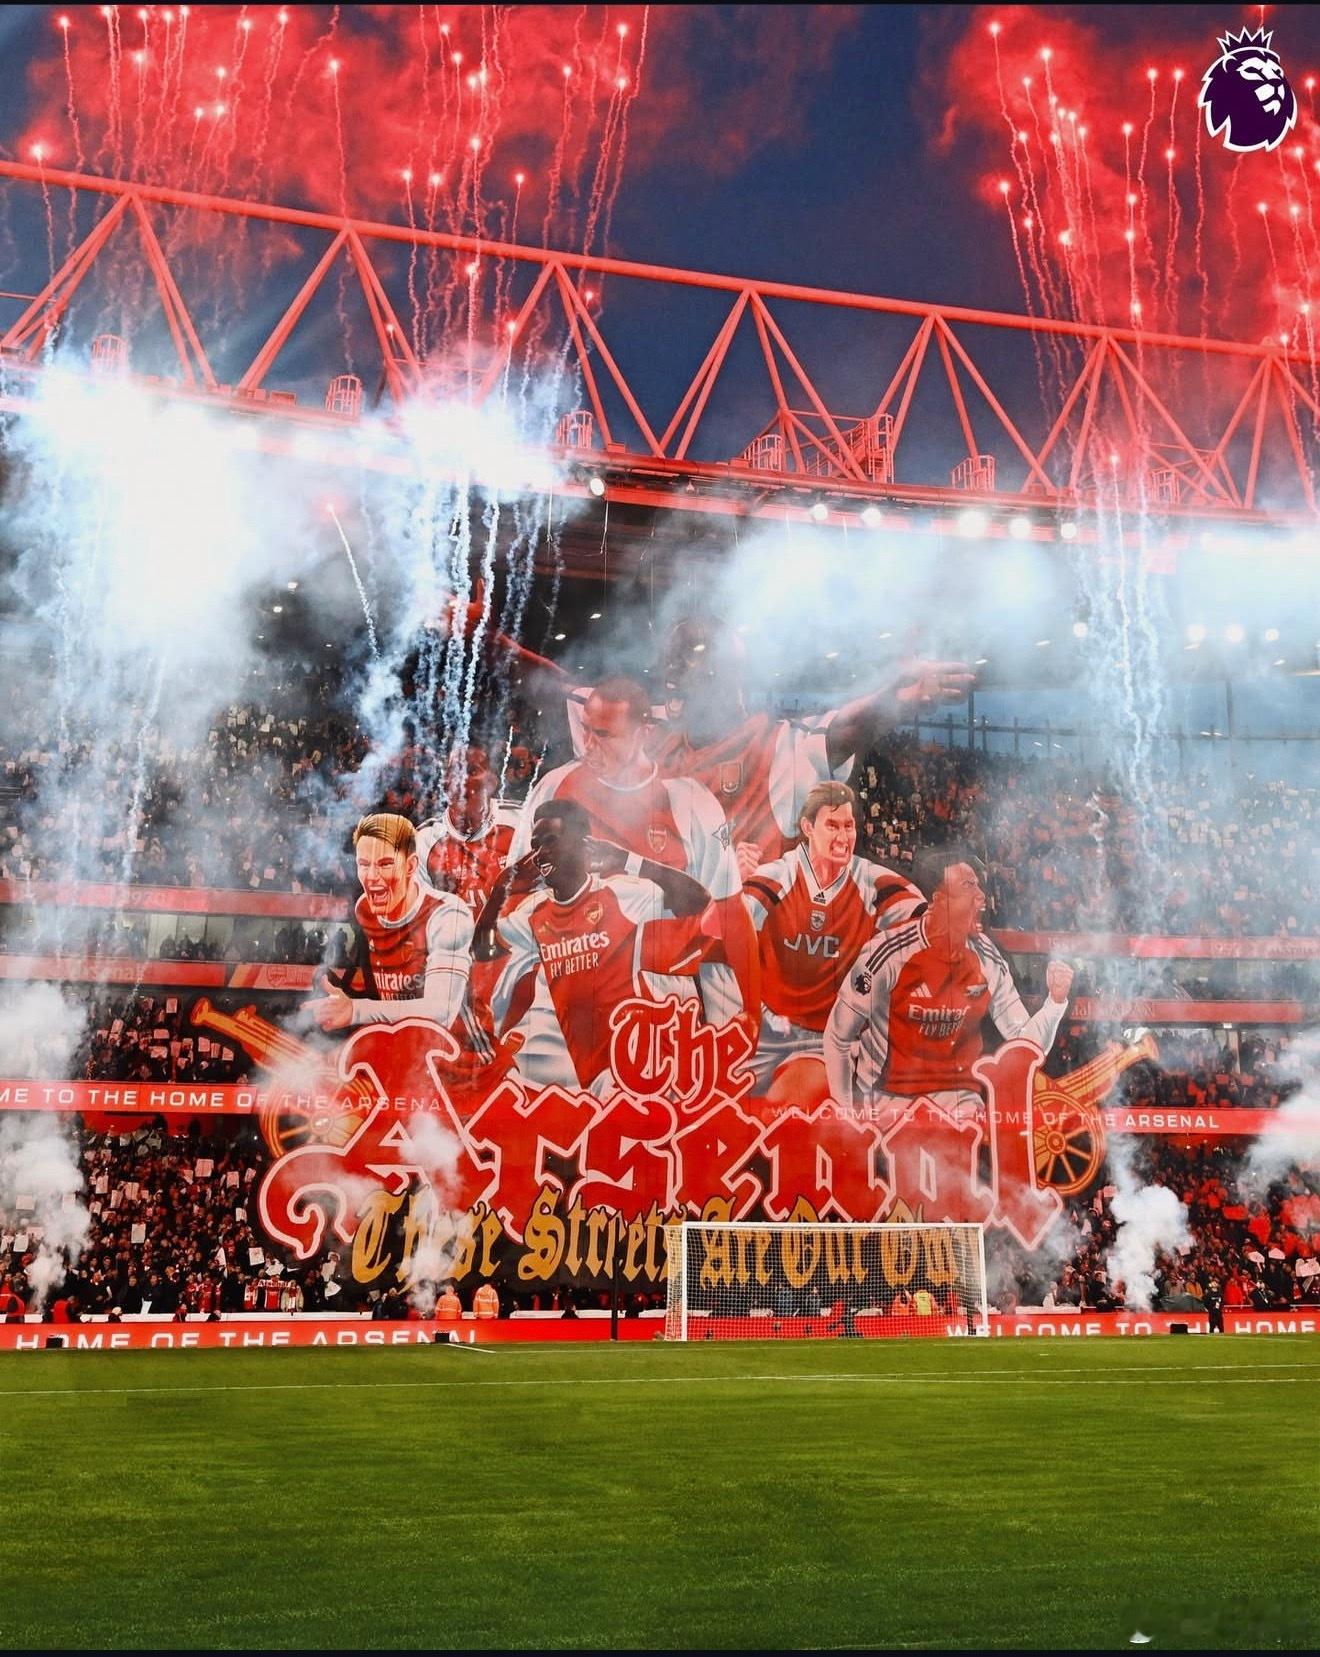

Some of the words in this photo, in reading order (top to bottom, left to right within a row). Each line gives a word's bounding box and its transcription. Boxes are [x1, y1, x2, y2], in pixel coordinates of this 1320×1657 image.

[540, 931, 610, 962] Emirates
[783, 933, 840, 958] JVC
[565, 951, 599, 975] BETTER
[373, 969, 425, 993] mirates
[609, 994, 755, 1114] The
[43, 1089, 74, 1104] TO
[87, 1089, 137, 1106] THE
[150, 1091, 224, 1107] HOME
[236, 1093, 269, 1108] OF
[341, 1096, 442, 1111] ARSENA
[1125, 1113, 1221, 1129] ARSENAL
[258, 1016, 1064, 1261] Arsenal
[352, 1184, 503, 1295] Thse
[219, 1331, 291, 1348] THE
